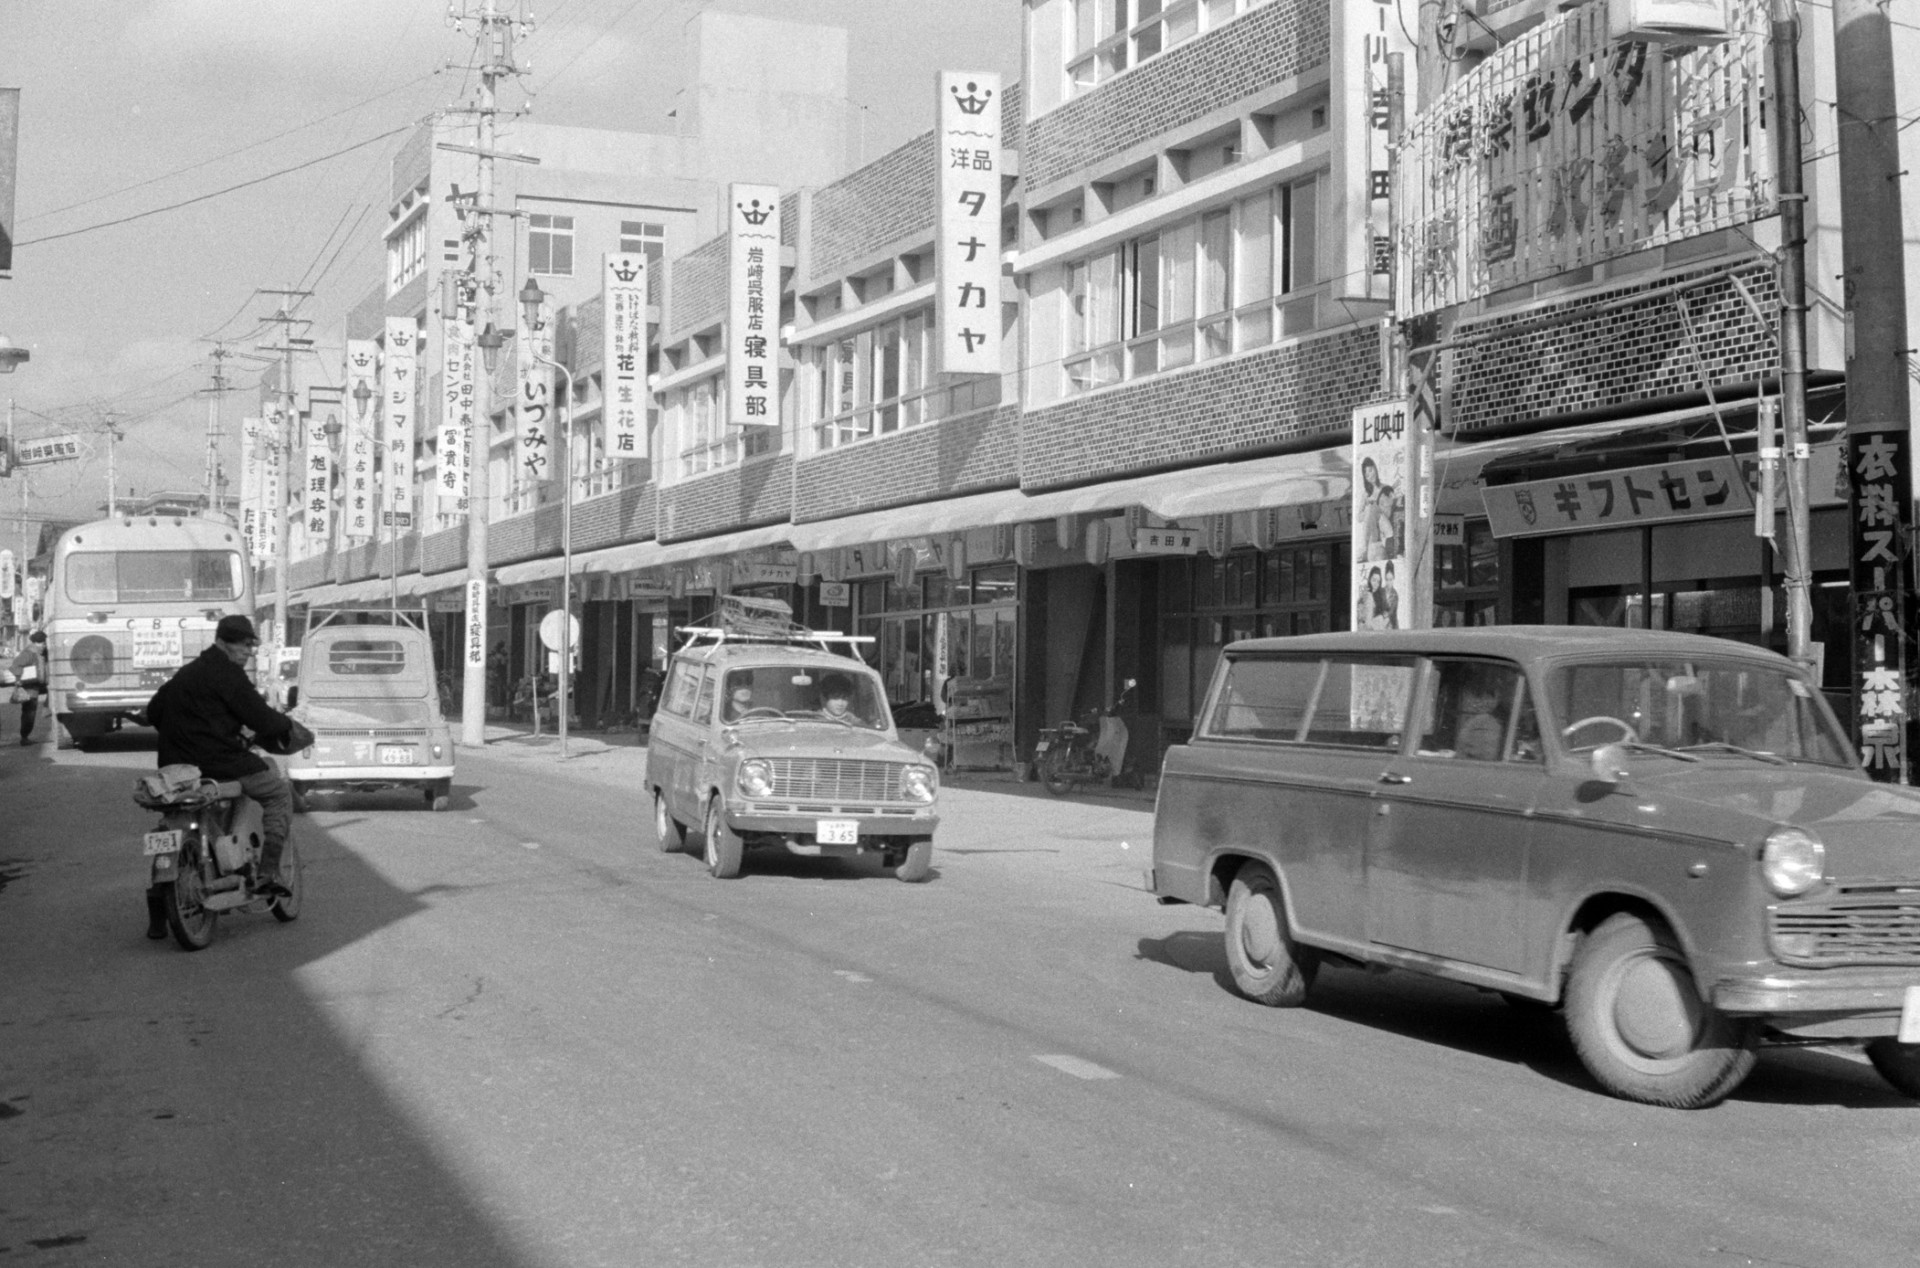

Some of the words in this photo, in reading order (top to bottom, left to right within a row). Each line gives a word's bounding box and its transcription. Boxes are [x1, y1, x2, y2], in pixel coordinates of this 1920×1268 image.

[950, 148, 992, 171] 洋品
[958, 190, 986, 353] タナカヤ
[524, 381, 547, 475] いづみや
[1360, 409, 1405, 445] 上映中
